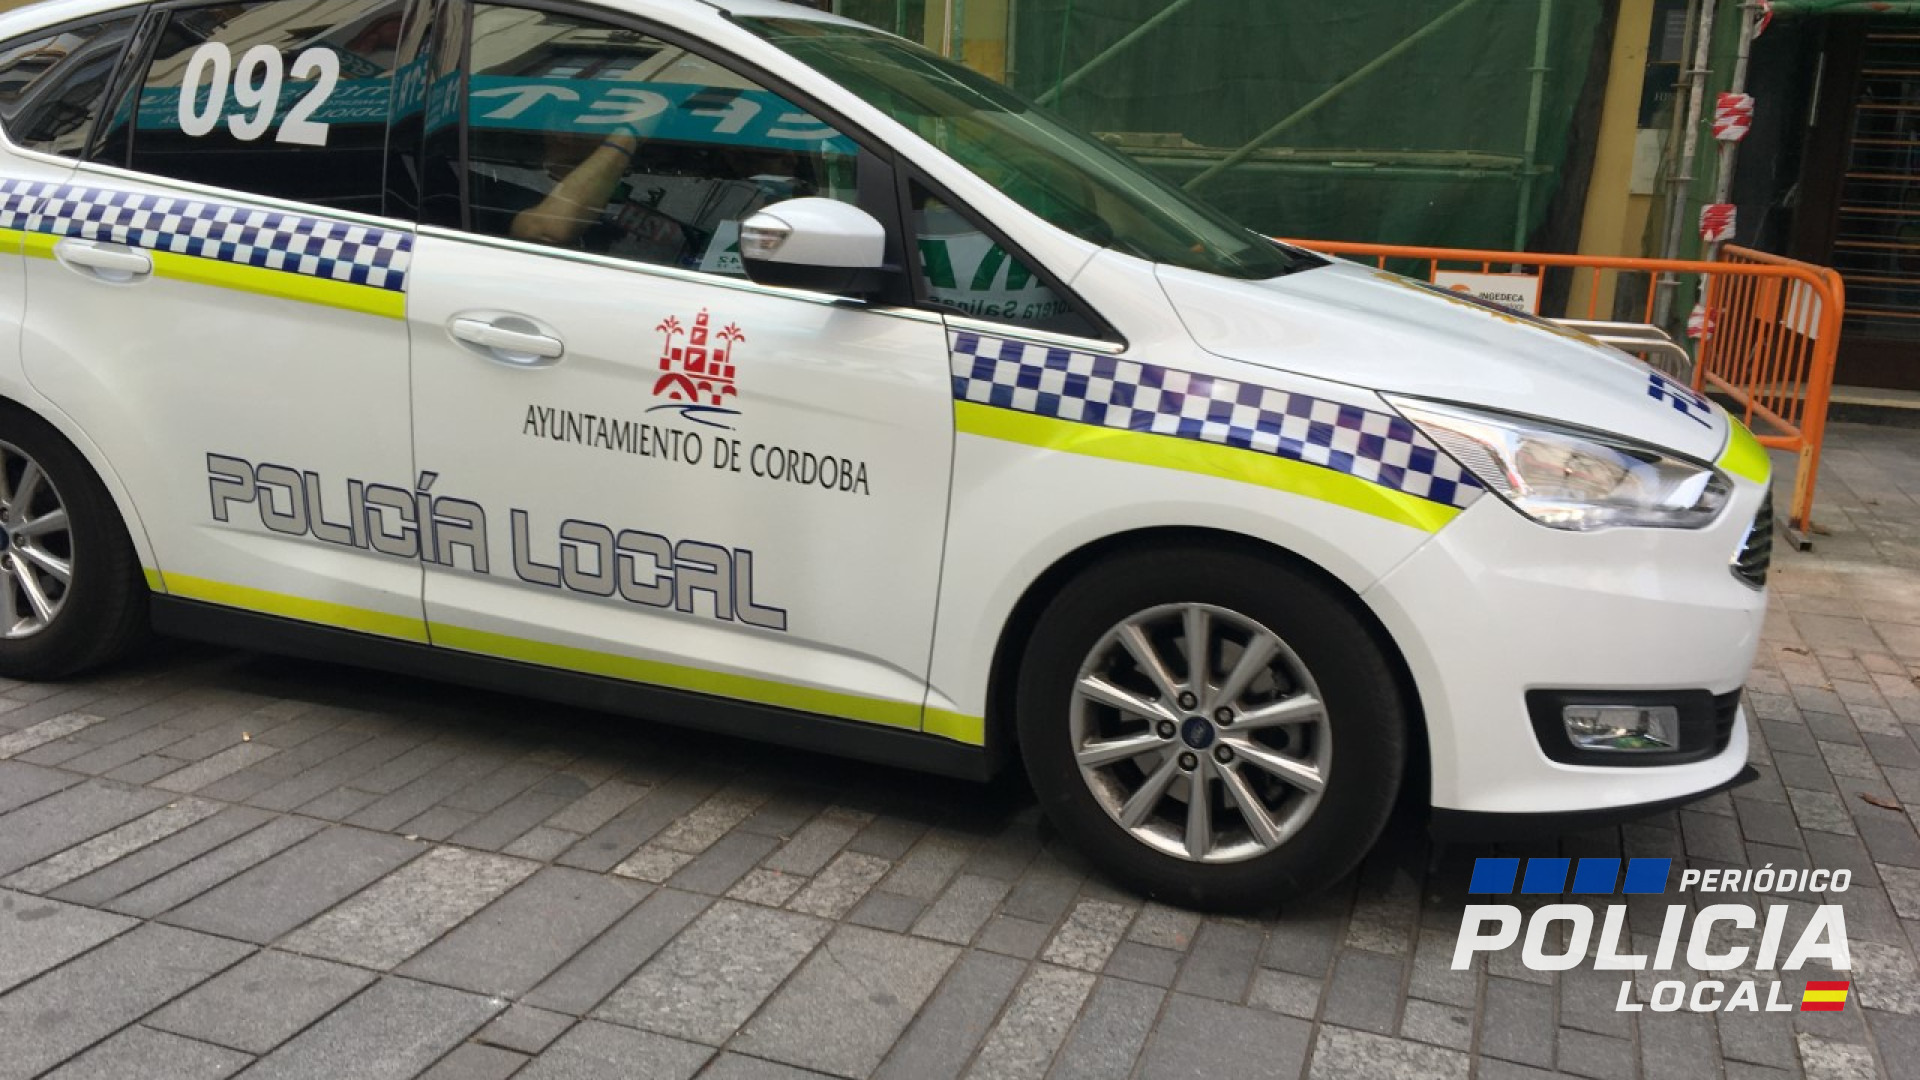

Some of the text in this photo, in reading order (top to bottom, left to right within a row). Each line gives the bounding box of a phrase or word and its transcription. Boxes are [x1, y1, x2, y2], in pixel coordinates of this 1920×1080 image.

[178, 41, 341, 147] 092
[523, 404, 870, 496] AYUNTAMIENTO DE CORDOBA
[206, 452, 787, 631] POLICÍA LOCAL
